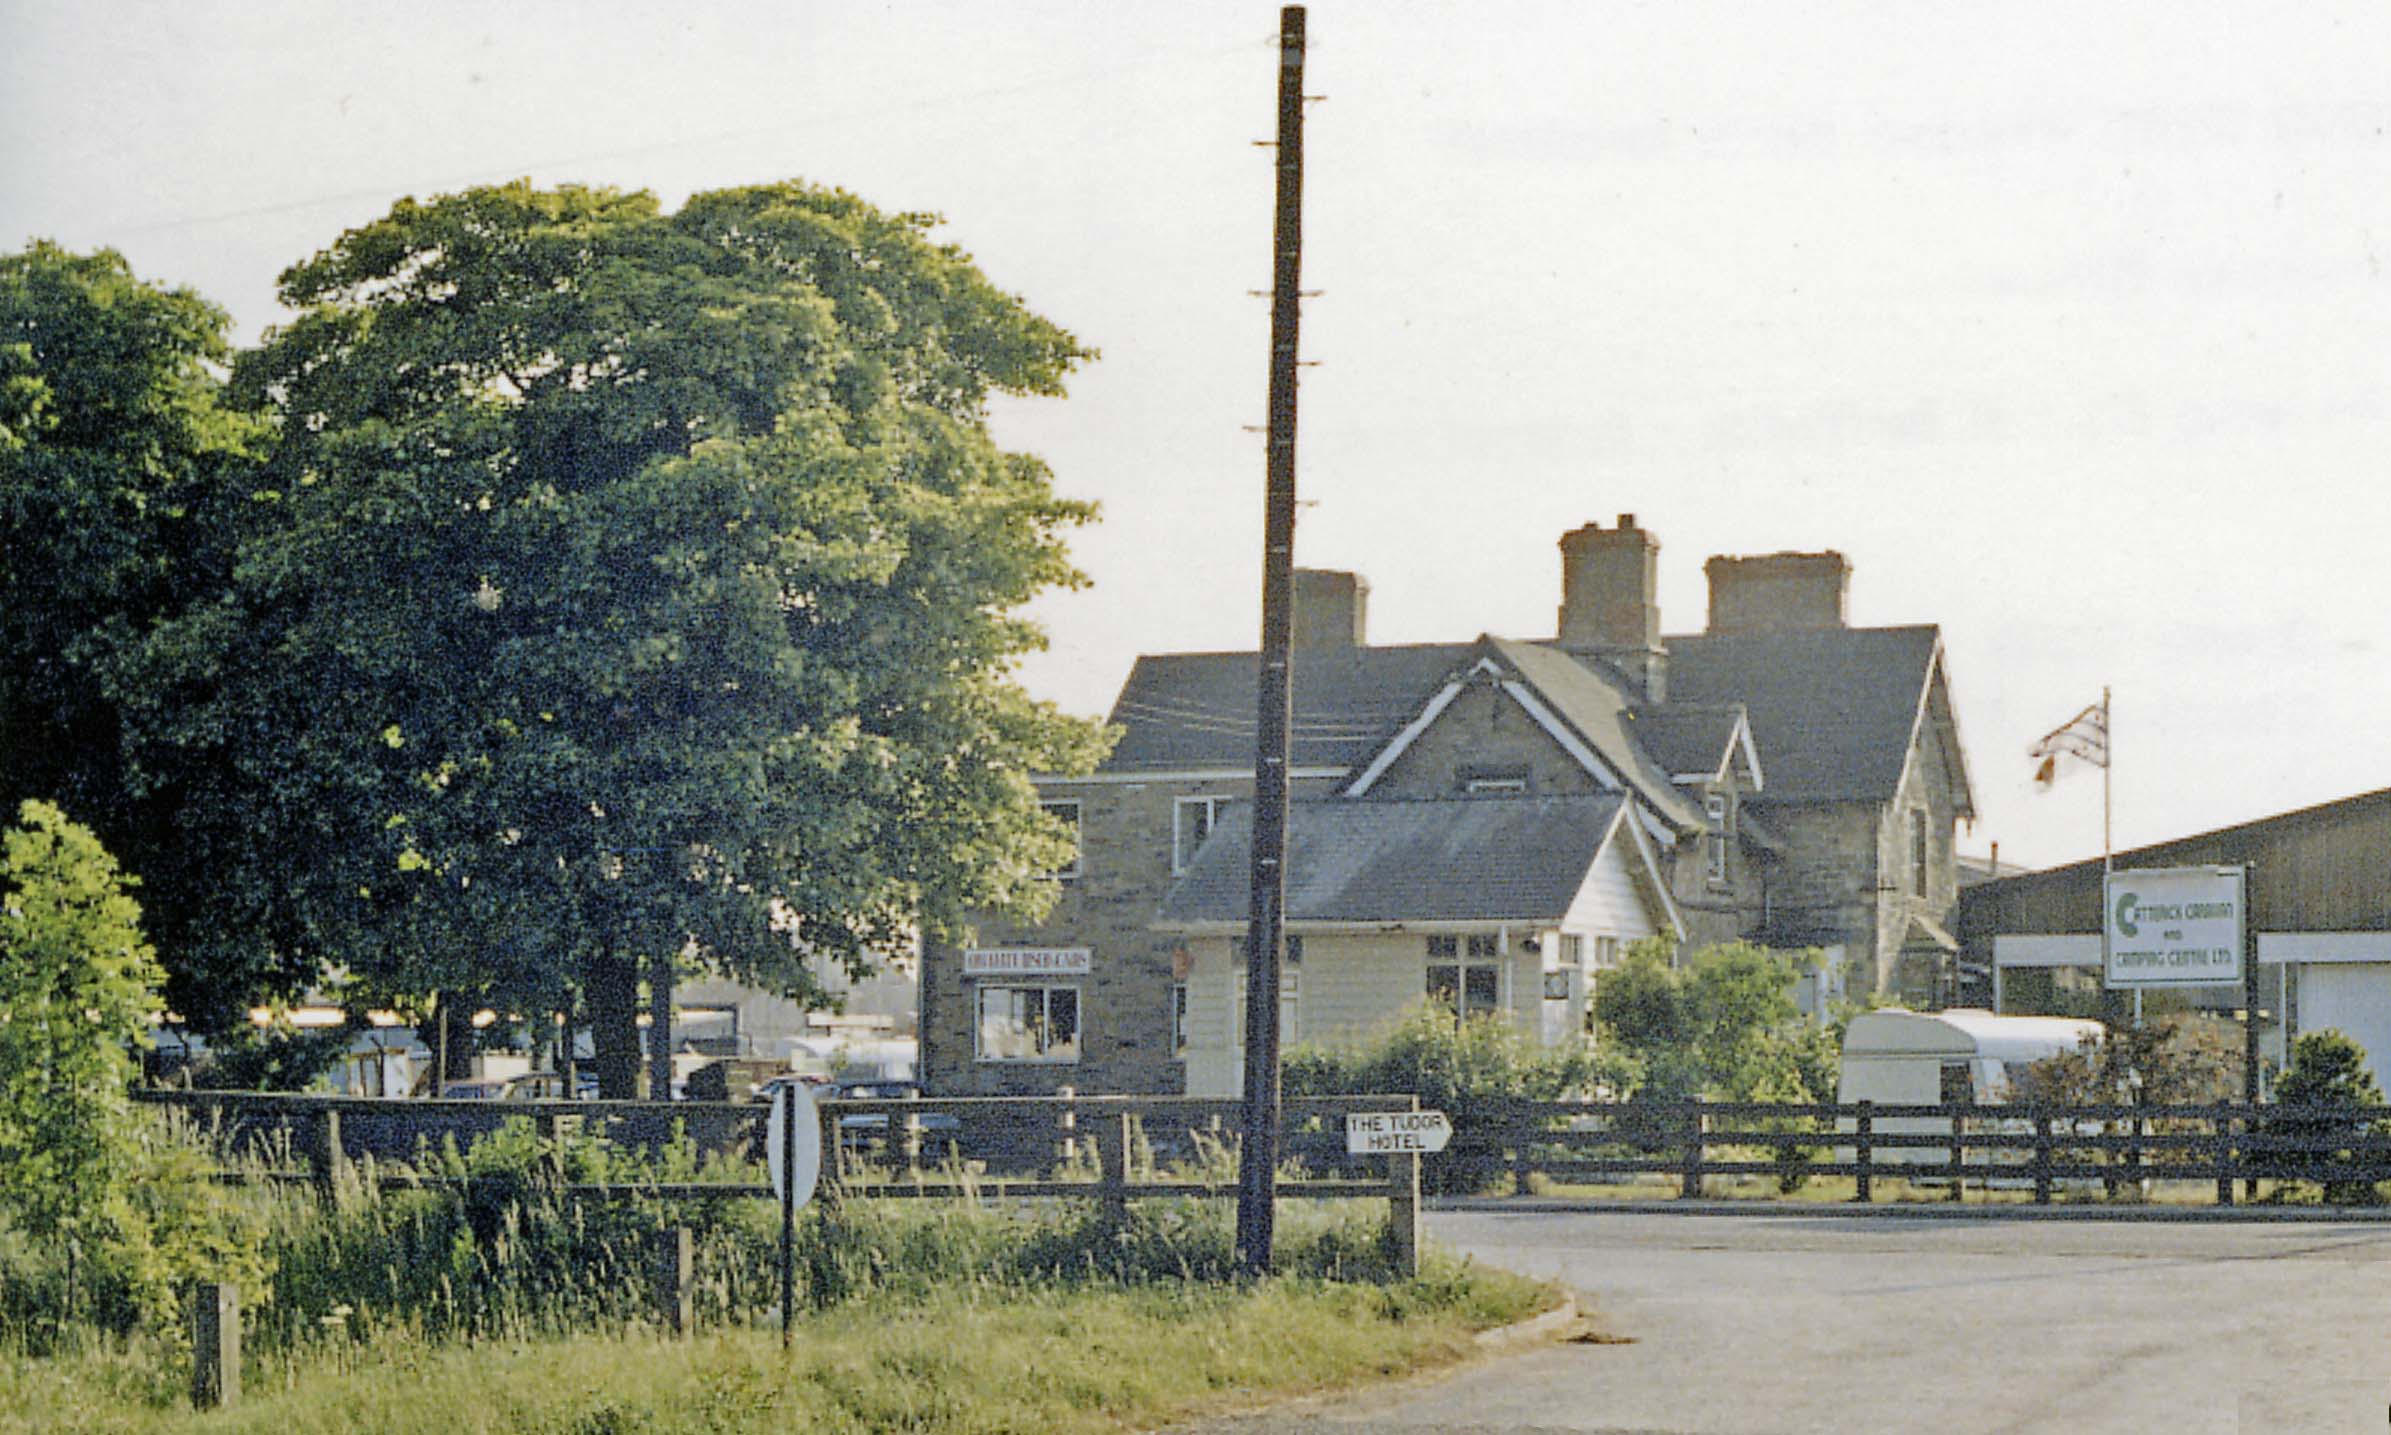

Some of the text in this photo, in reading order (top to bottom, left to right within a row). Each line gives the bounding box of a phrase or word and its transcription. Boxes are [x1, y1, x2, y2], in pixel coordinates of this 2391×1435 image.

[1351, 1115, 1442, 1131] THE TUDOR
[1368, 1133, 1426, 1149] HOTEL
